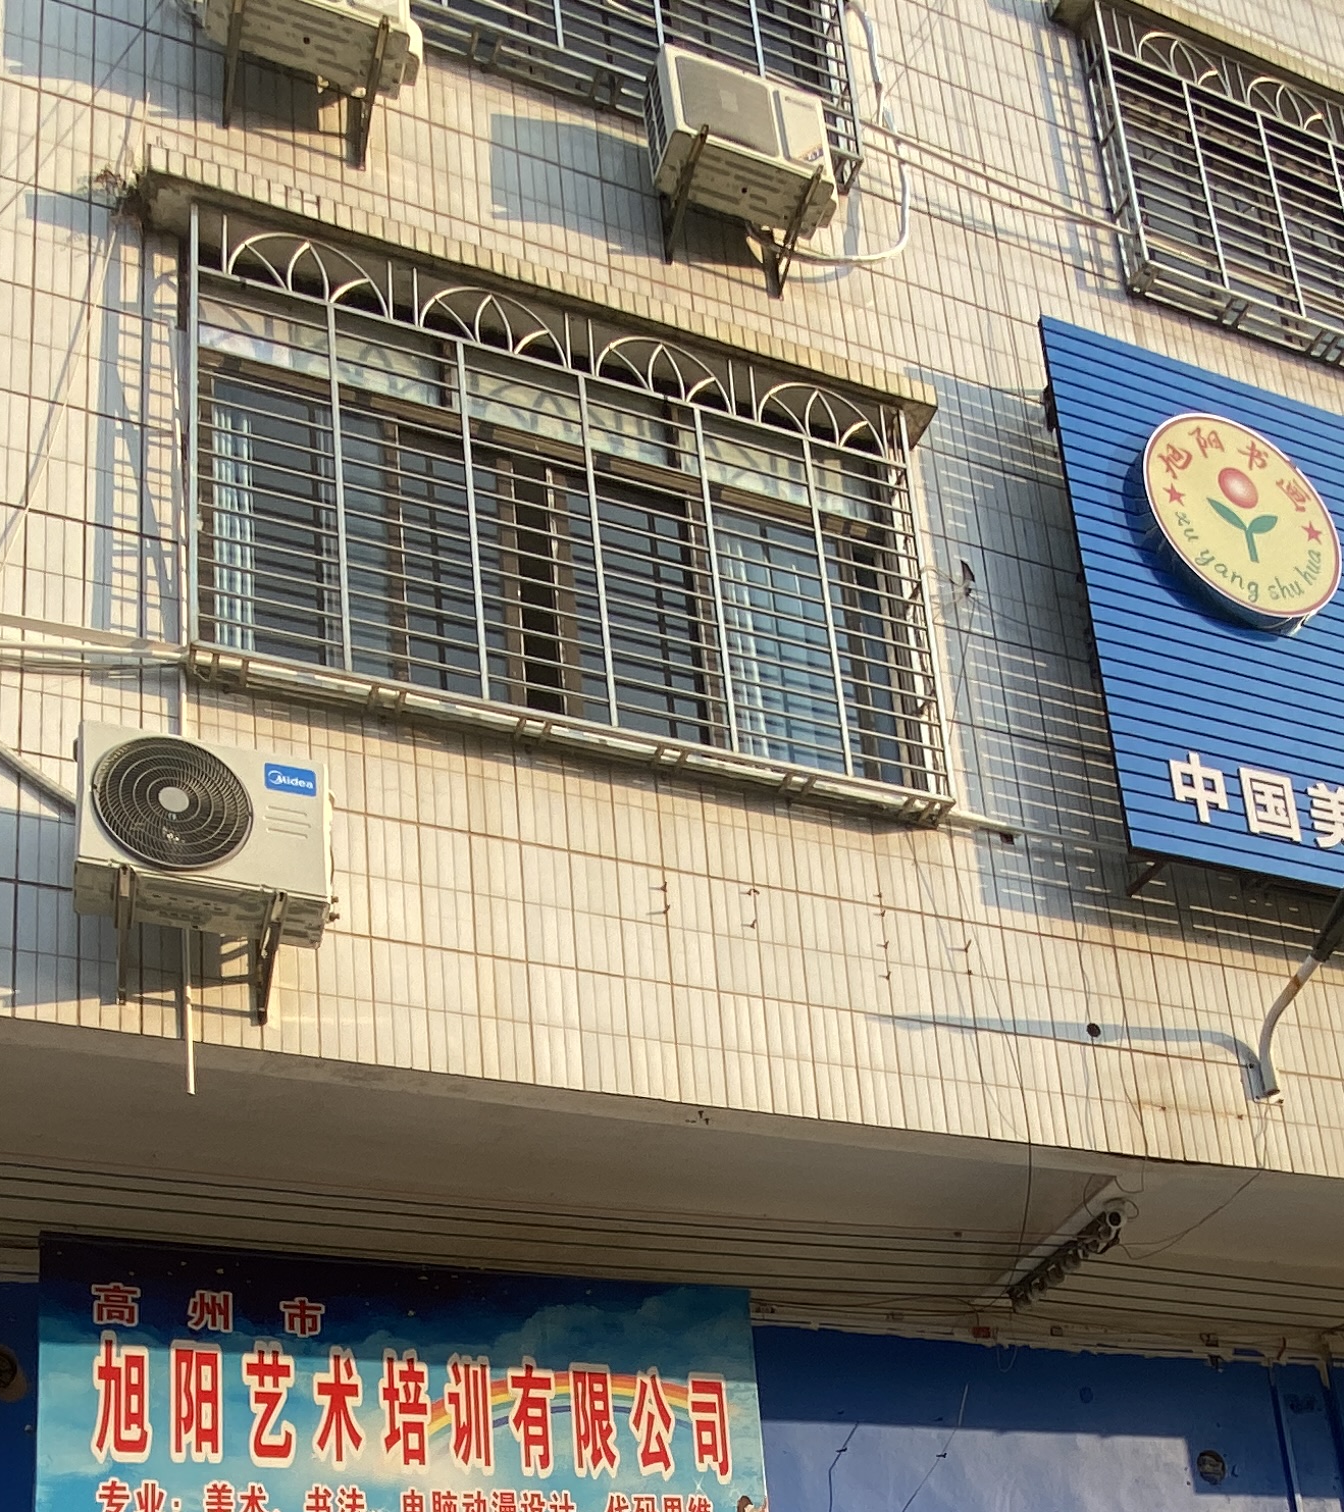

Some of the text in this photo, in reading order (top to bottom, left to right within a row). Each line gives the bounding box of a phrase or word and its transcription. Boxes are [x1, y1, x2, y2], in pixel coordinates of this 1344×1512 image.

[1157, 426, 1312, 513] 旭阳书画
[1175, 511, 1322, 603] xu yang shu hua
[269, 771, 314, 789] Midea
[92, 1283, 325, 1337] 高州市
[91, 1331, 734, 1481] 旭阳艺术培训有限公司
